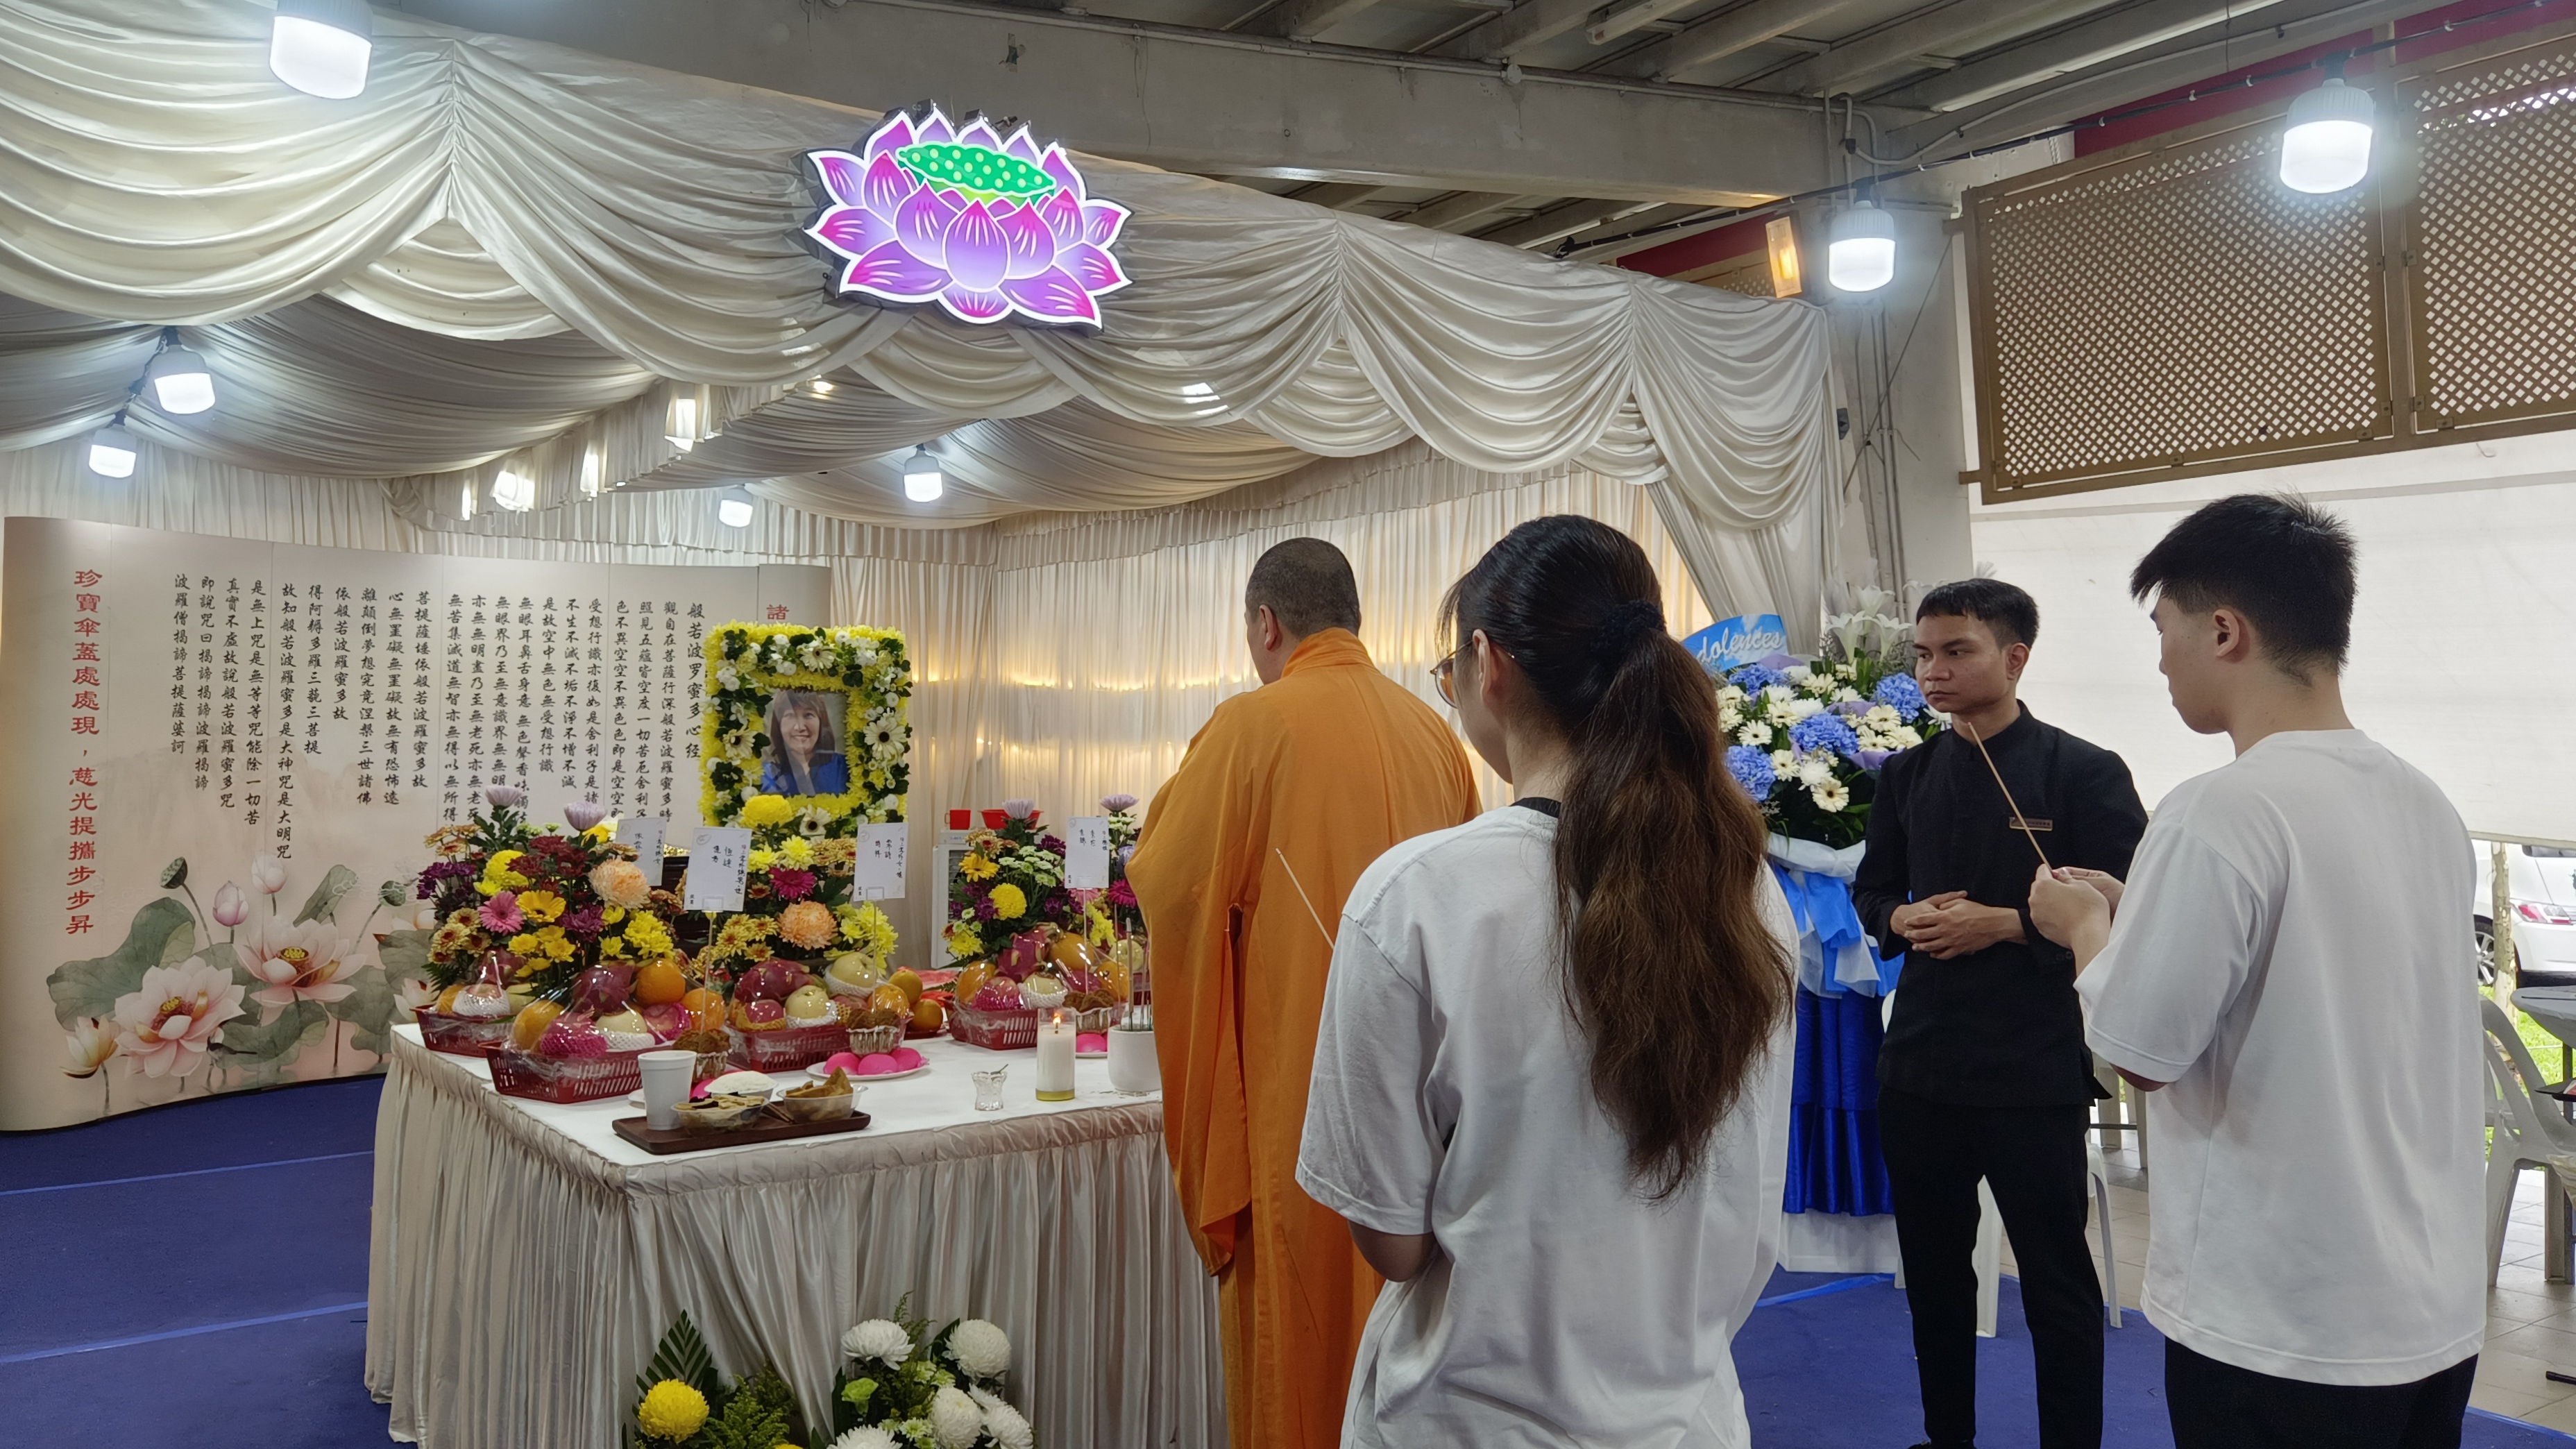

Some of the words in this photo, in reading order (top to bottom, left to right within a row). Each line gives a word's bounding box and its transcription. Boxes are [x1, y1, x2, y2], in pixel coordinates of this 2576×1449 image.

[332, 587, 351, 720] 依般若波羅蜜多故
[443, 594, 463, 826] 無苦集滅道無智亦無得以無所得
